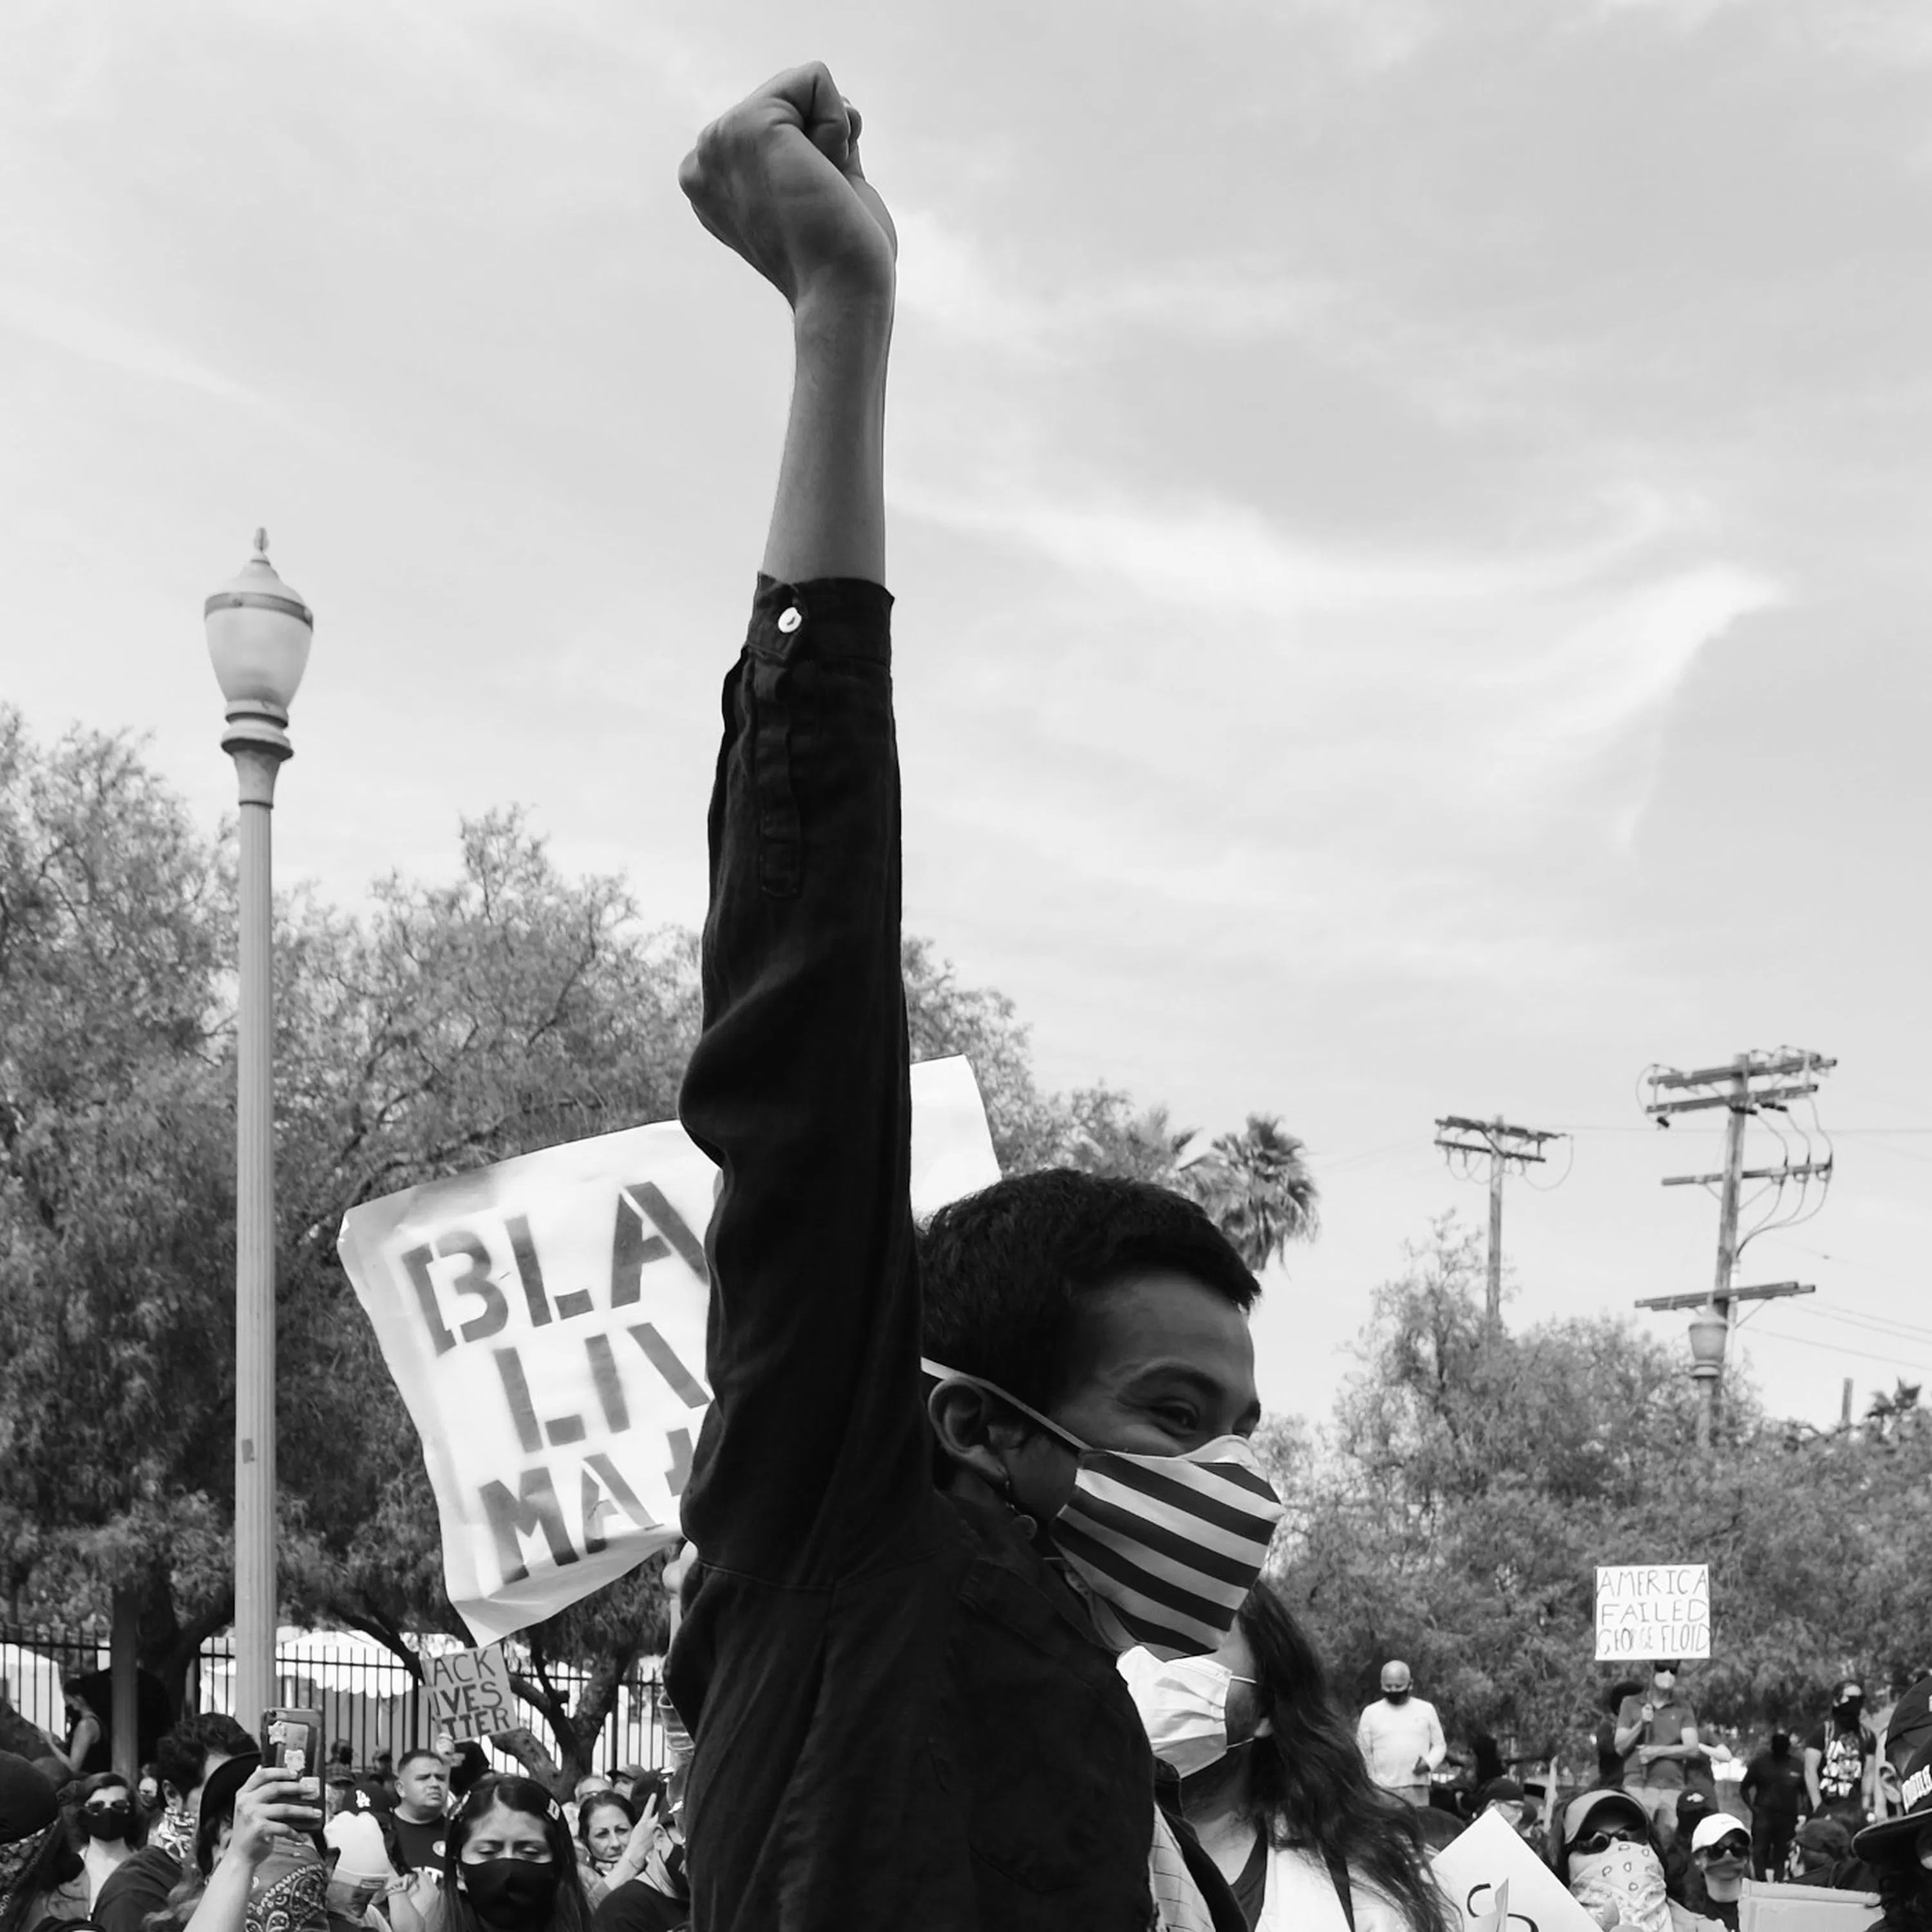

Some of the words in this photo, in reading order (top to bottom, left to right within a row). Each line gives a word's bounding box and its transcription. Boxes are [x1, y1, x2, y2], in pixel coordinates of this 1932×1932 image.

[400, 1181, 710, 1358] BLA
[1596, 1569, 1709, 1598] AMERICA
[1602, 1599, 1709, 1625] FAILED
